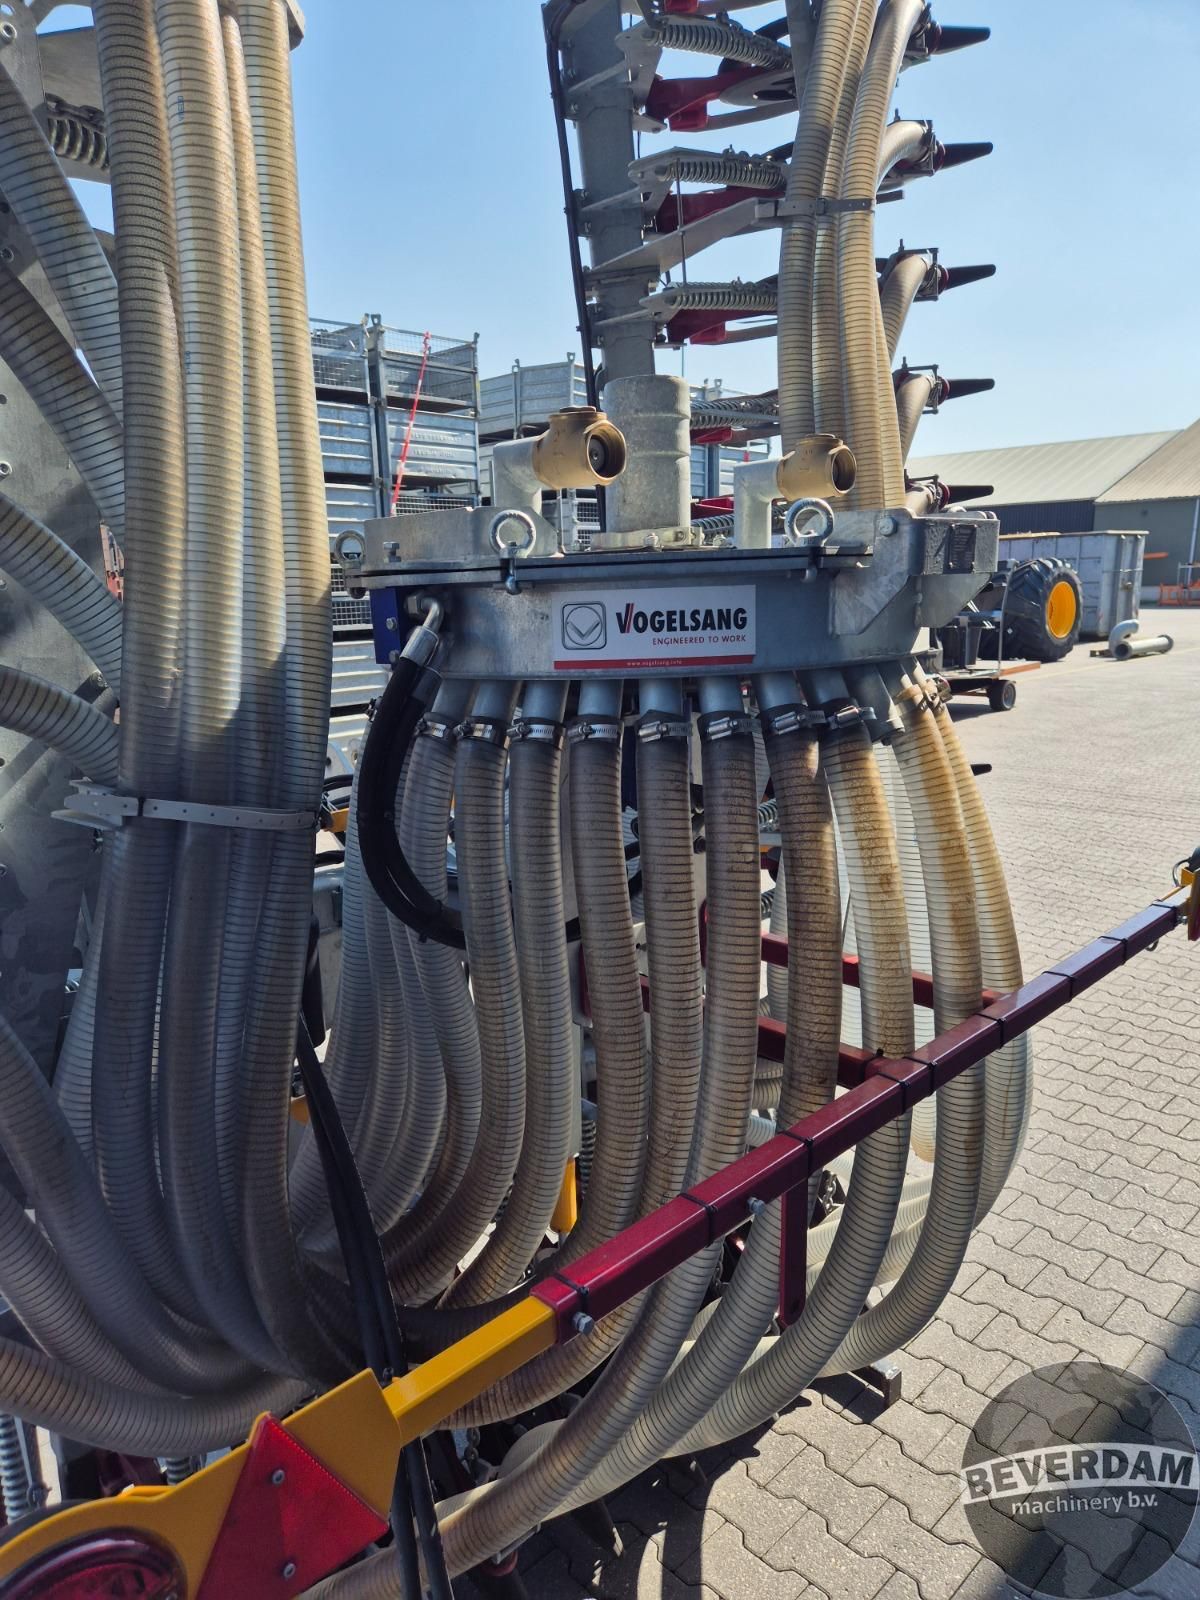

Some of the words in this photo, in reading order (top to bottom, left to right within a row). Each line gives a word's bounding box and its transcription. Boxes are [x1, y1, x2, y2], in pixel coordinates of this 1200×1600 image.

[616, 602, 748, 634] VOGELSANG
[652, 637, 705, 646] ENGINEERED
[721, 634, 746, 643] WORK
